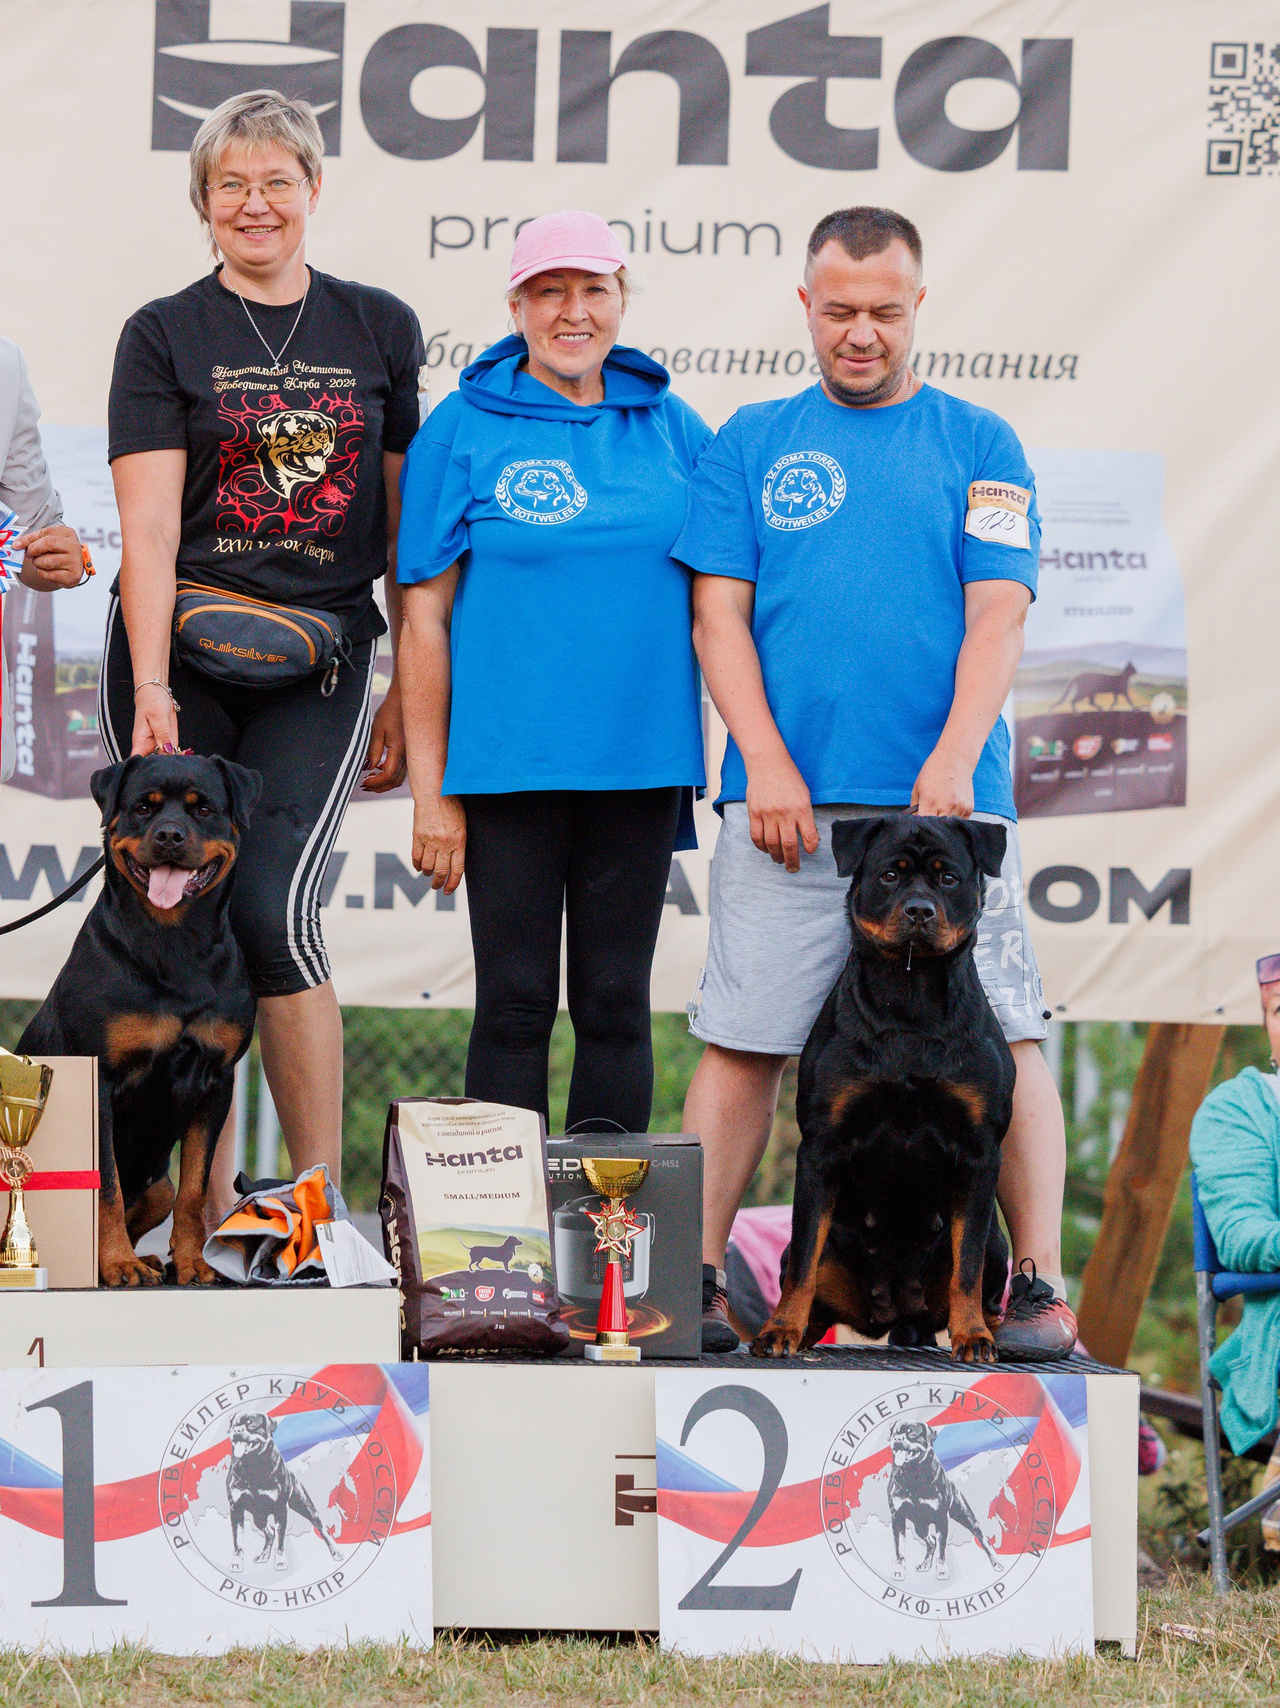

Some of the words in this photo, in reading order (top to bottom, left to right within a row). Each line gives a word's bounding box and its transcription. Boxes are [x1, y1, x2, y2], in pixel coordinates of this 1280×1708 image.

[151, 0, 1074, 172] Hanta
[430, 208, 783, 260] prium
[293, 360, 352, 375] Чемпионат
[213, 379, 279, 393] Победитель
[283, 377, 320, 391] Клуба
[775, 453, 805, 470] DOMA
[807, 453, 838, 473] TORRA
[972, 486, 1026, 505] Hanta
[512, 507, 576, 523] ROTTWEILER
[770, 508, 830, 528] ROTTWEILER
[198, 637, 288, 664] QUIKSILVER
[425, 1145, 524, 1167] Hanta
[548, 1158, 581, 1171] ED
[652, 1159, 680, 1168] C-M51
[443, 1192, 521, 1200] SMALL/MEDIUM
[162, 1383, 252, 1550] РОТВЕЙЛЕР
[269, 1380, 348, 1415] КЛУБ
[354, 1420, 394, 1549] РОССИИ
[823, 1391, 912, 1556] РОТВЕЙЛЕР
[928, 1387, 1007, 1427] КЛУБ
[1012, 1430, 1053, 1558] РОССИИ
[25, 1380, 128, 1608] 1
[677, 1383, 803, 1611] 2
[218, 1571, 346, 1607] РКФ-НКПР
[881, 1580, 1008, 1617] РКФ-НКПР
